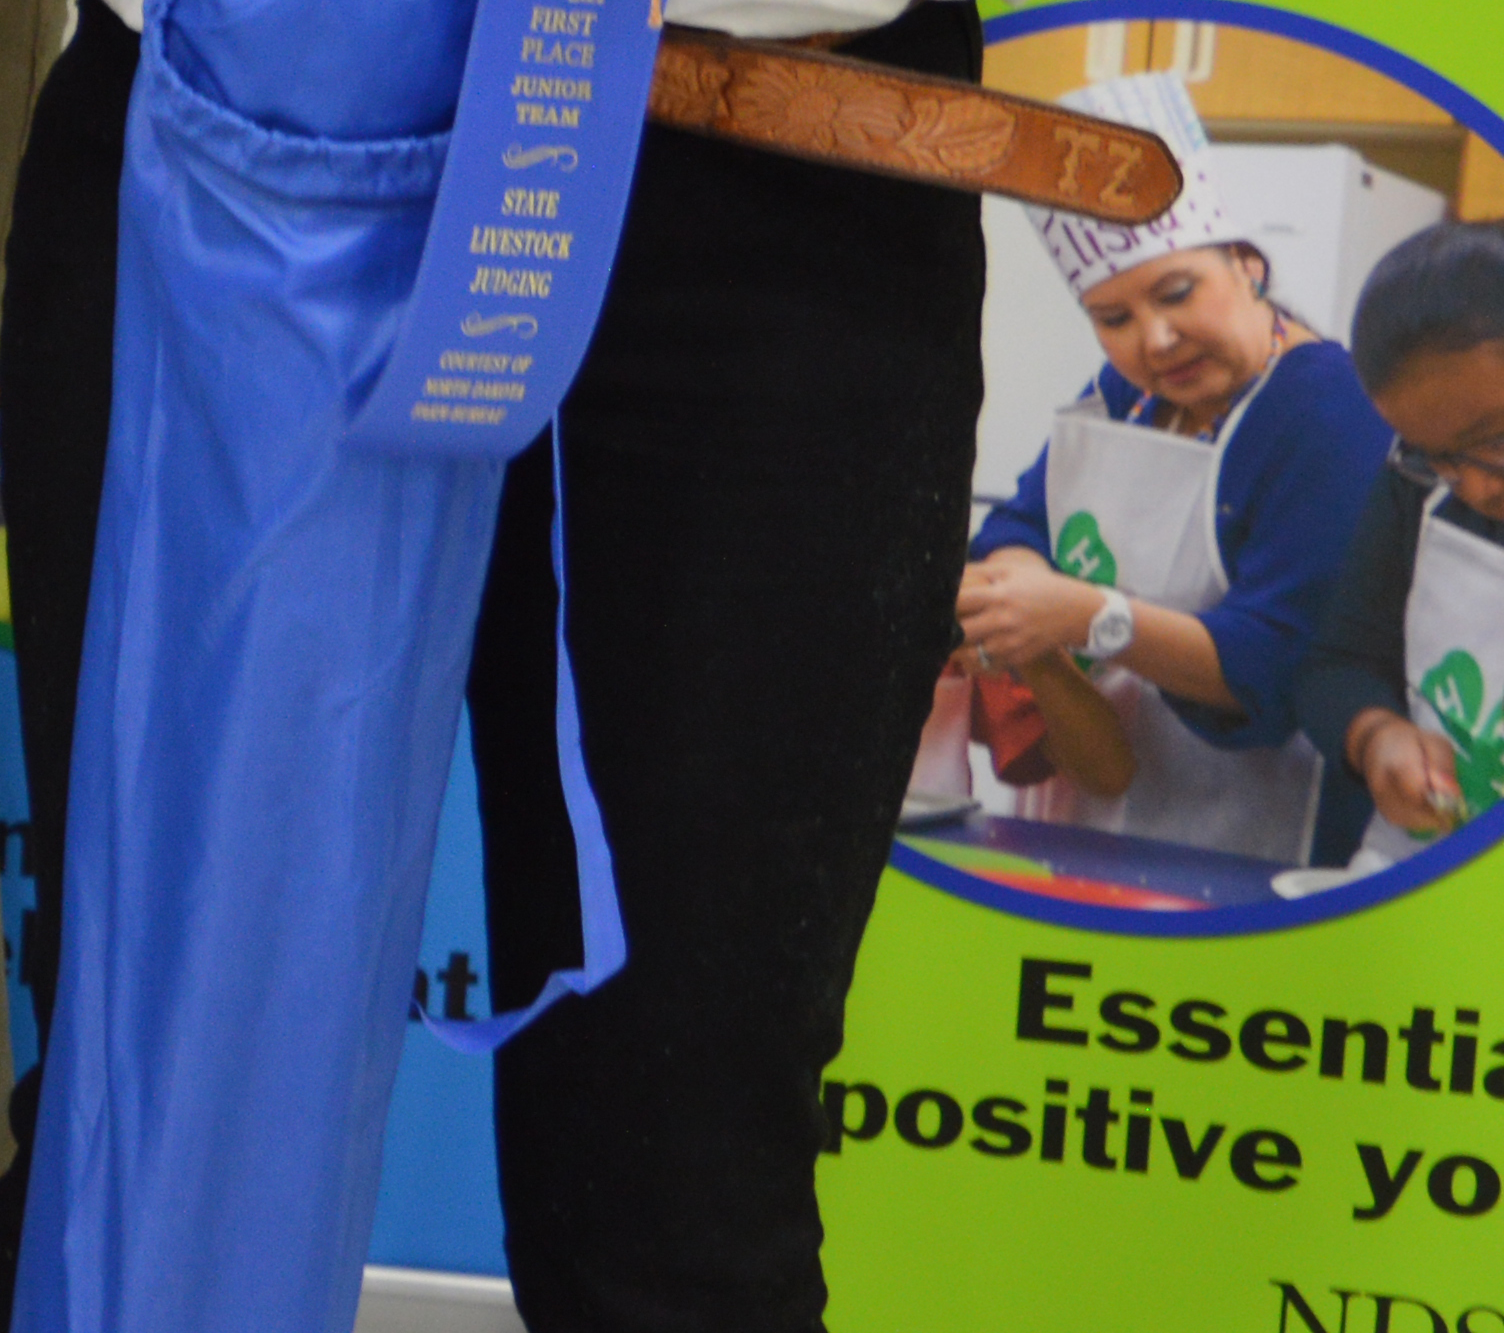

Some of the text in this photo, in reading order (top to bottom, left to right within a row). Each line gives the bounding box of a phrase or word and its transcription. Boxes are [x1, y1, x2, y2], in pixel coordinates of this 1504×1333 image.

[530, 5, 598, 37] FIRST
[521, 36, 595, 69] PLACE
[511, 75, 592, 102] JUNIOR
[516, 101, 581, 128] TEAM
[1054, 124, 1144, 207] TZ
[501, 187, 561, 219] STATE
[469, 224, 574, 260] LIVESTOCK
[469, 264, 553, 299] JUDGING
[1352, 1141, 1501, 1221] yo
